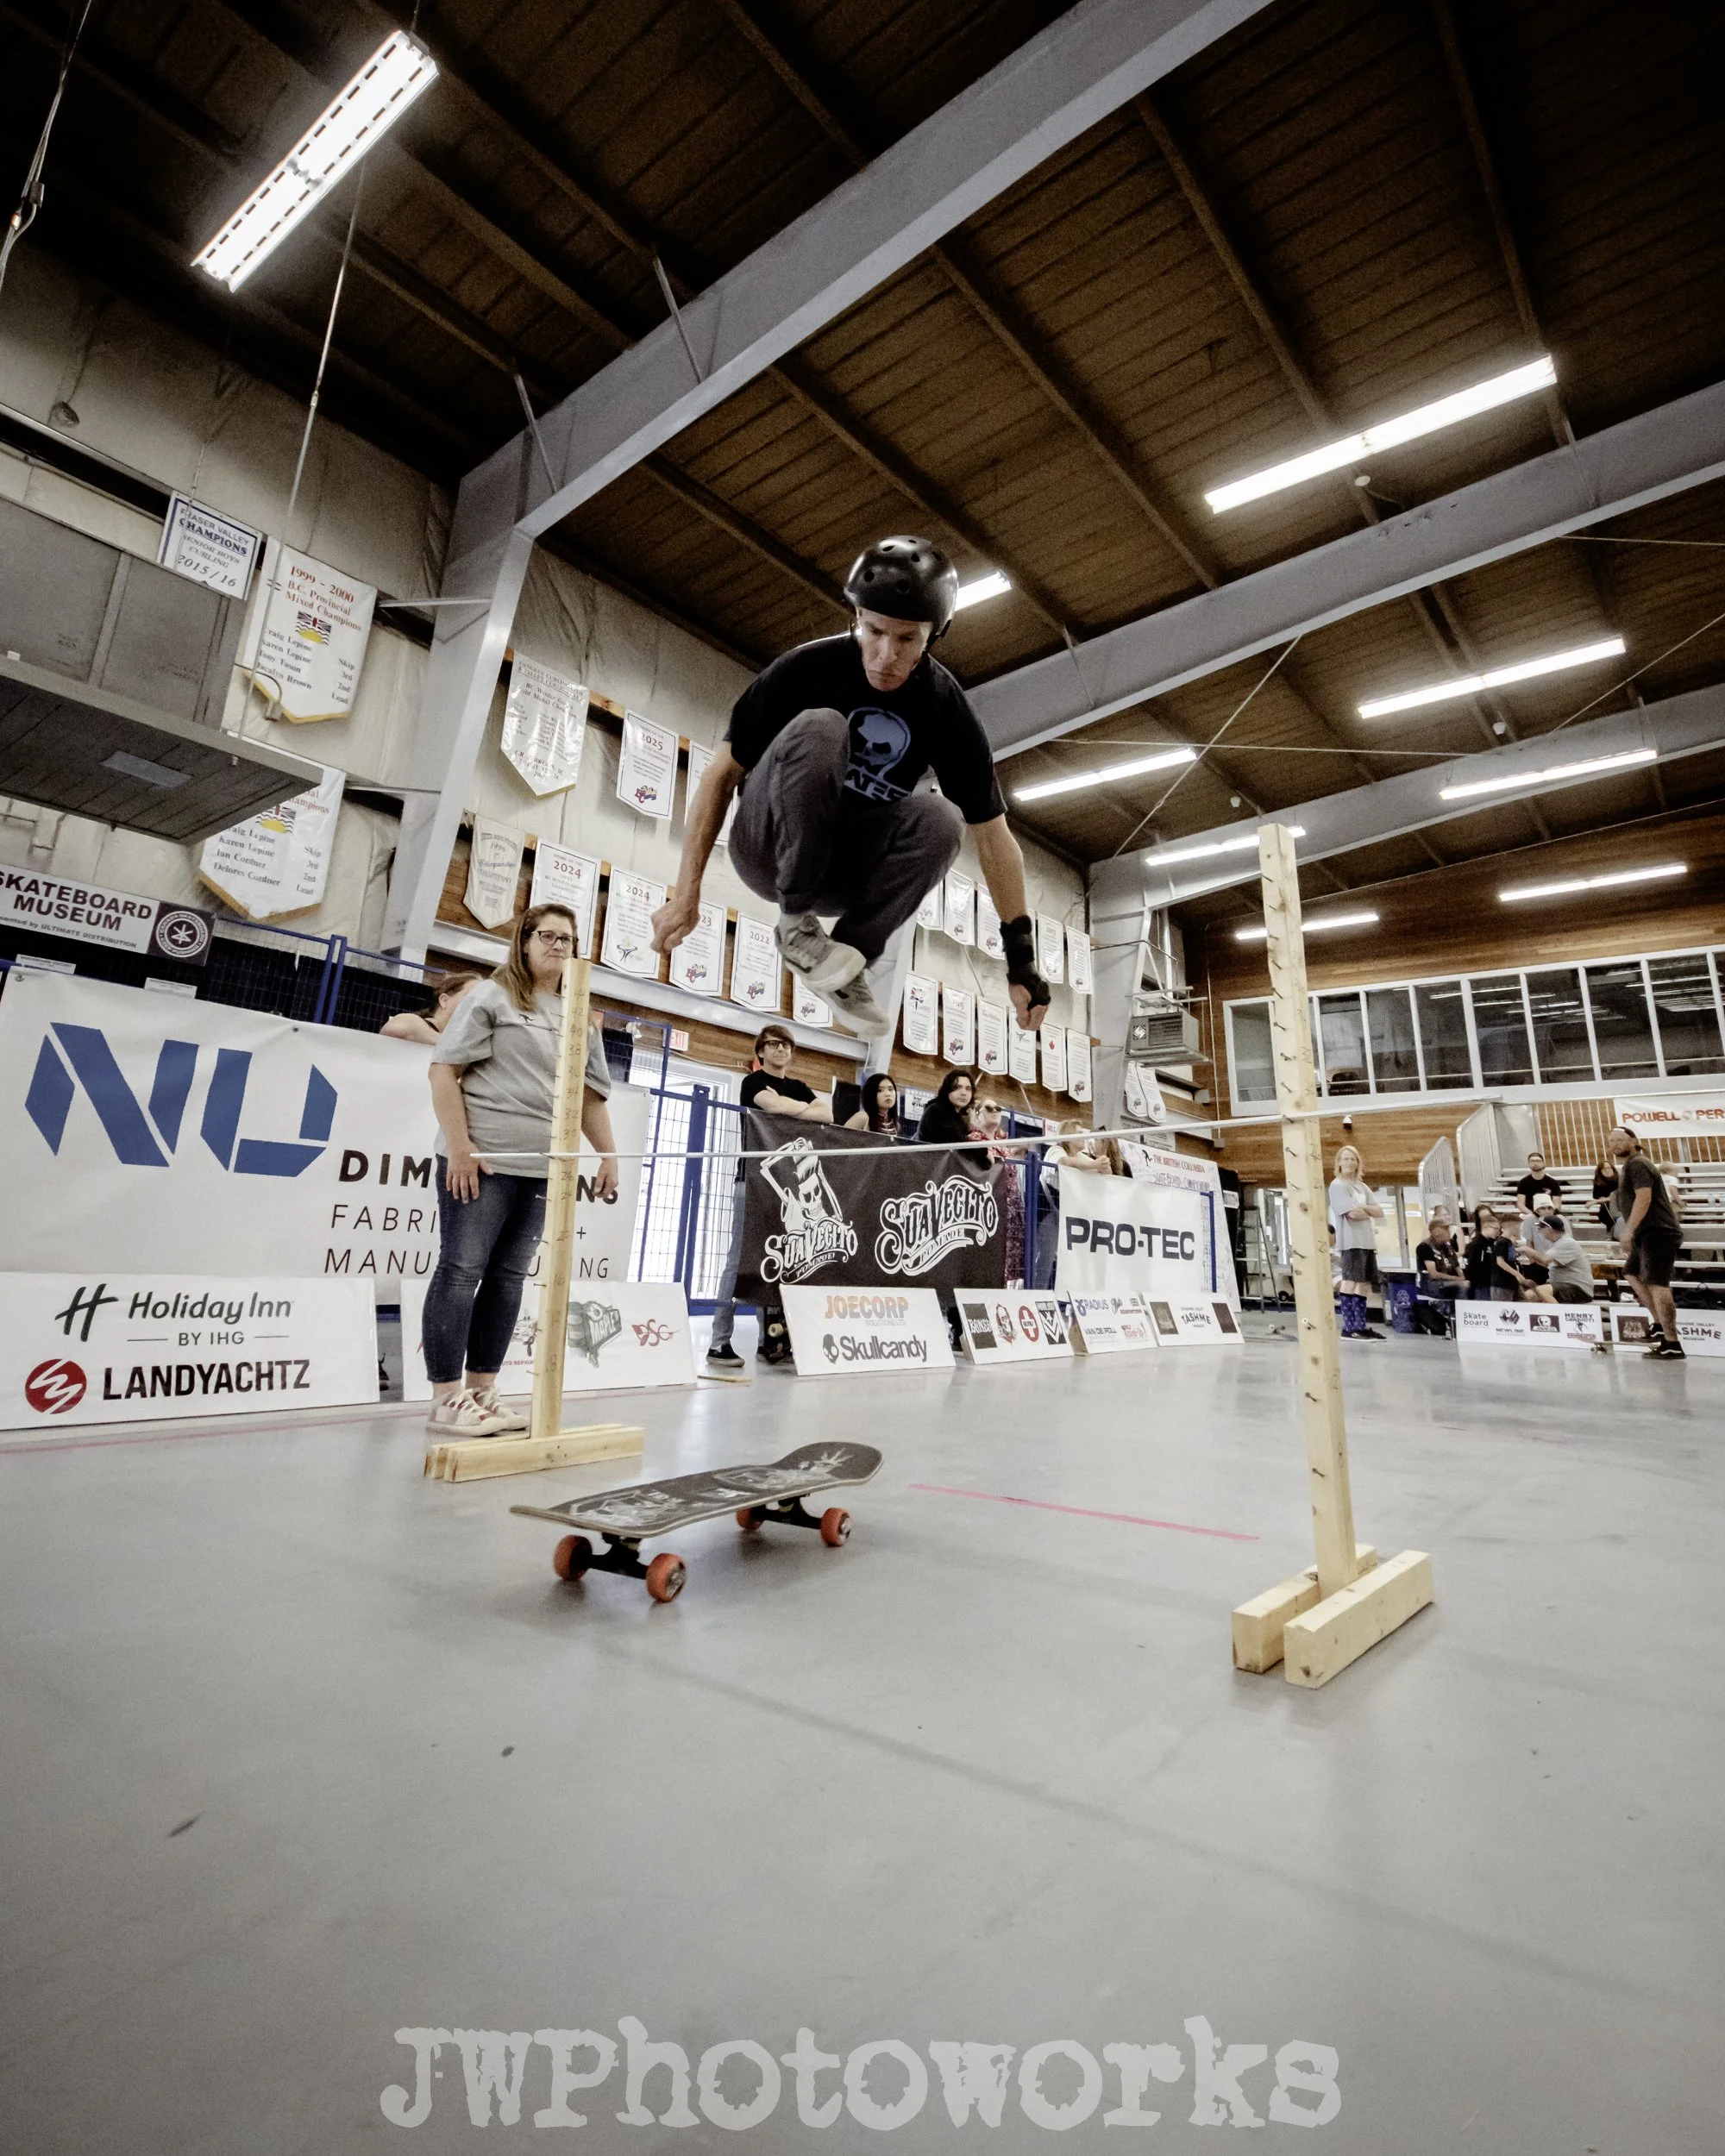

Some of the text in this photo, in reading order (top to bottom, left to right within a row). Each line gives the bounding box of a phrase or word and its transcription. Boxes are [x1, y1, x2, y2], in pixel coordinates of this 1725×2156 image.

[179, 517, 248, 555] CHAMPIONS
[217, 525, 249, 545] VALLEY
[189, 546, 229, 568] CURLING
[217, 547, 240, 564] BOYS
[290, 566, 317, 584] 1999
[329, 584, 354, 603] 2000
[310, 590, 351, 616] Provincial
[285, 591, 363, 631] Mixed Champions
[267, 628, 285, 642] raig
[286, 674, 312, 689] Brown
[337, 682, 351, 693] 2nd
[228, 825, 246, 836] raig
[219, 836, 245, 849] Karen
[303, 873, 316, 883] 2nd
[553, 860, 582, 881] 2024
[626, 885, 650, 901] 2024
[14, 894, 122, 931] MUSEUM
[0, 916, 137, 949] sented by ULTIMATE DISTRIBUTION
[750, 931, 770, 944] 2022
[568, 1044, 581, 1056] 38
[1622, 1108, 1725, 1123] POWELL PER
[128, 1292, 292, 1326] Holiday Inn
[825, 1295, 909, 1319] JOECORP
[1084, 1299, 1109, 1310] RADIUS
[1181, 1313, 1212, 1325] TASHME
[1463, 1312, 1487, 1320] Skate
[1464, 1319, 1489, 1327] board
[178, 1331, 245, 1346] BY IHG
[1676, 1326, 1722, 1339] SHME
[839, 1334, 927, 1363] Skullcandy
[103, 1359, 310, 1401] LANDYACHTZ
